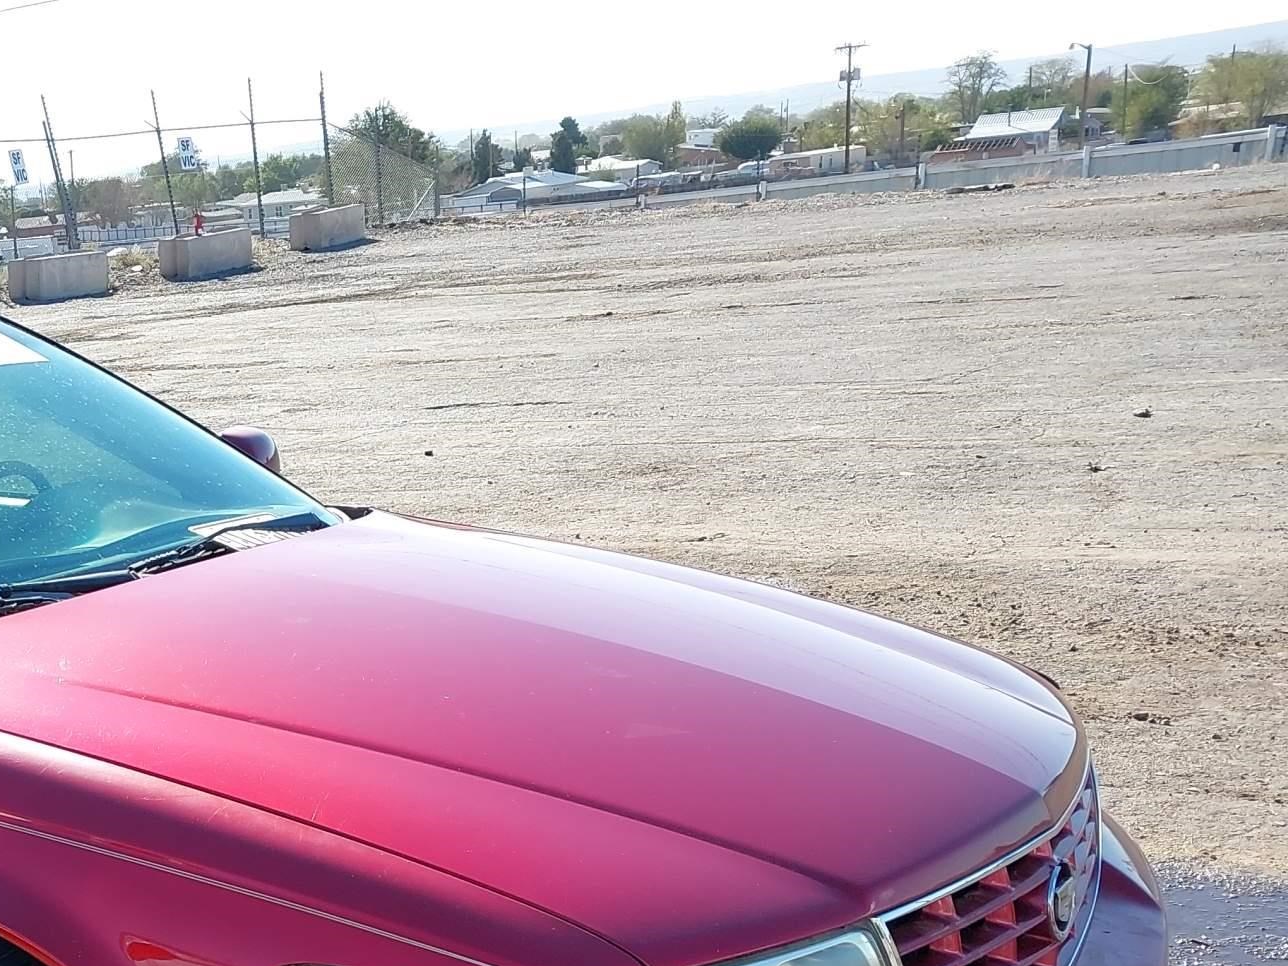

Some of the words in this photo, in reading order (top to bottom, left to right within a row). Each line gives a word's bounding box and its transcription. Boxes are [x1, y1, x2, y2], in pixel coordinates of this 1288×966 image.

[181, 139, 190, 152] SF
[11, 151, 21, 165] SF
[181, 155, 196, 168] VIC
[13, 168, 28, 182] VIC
